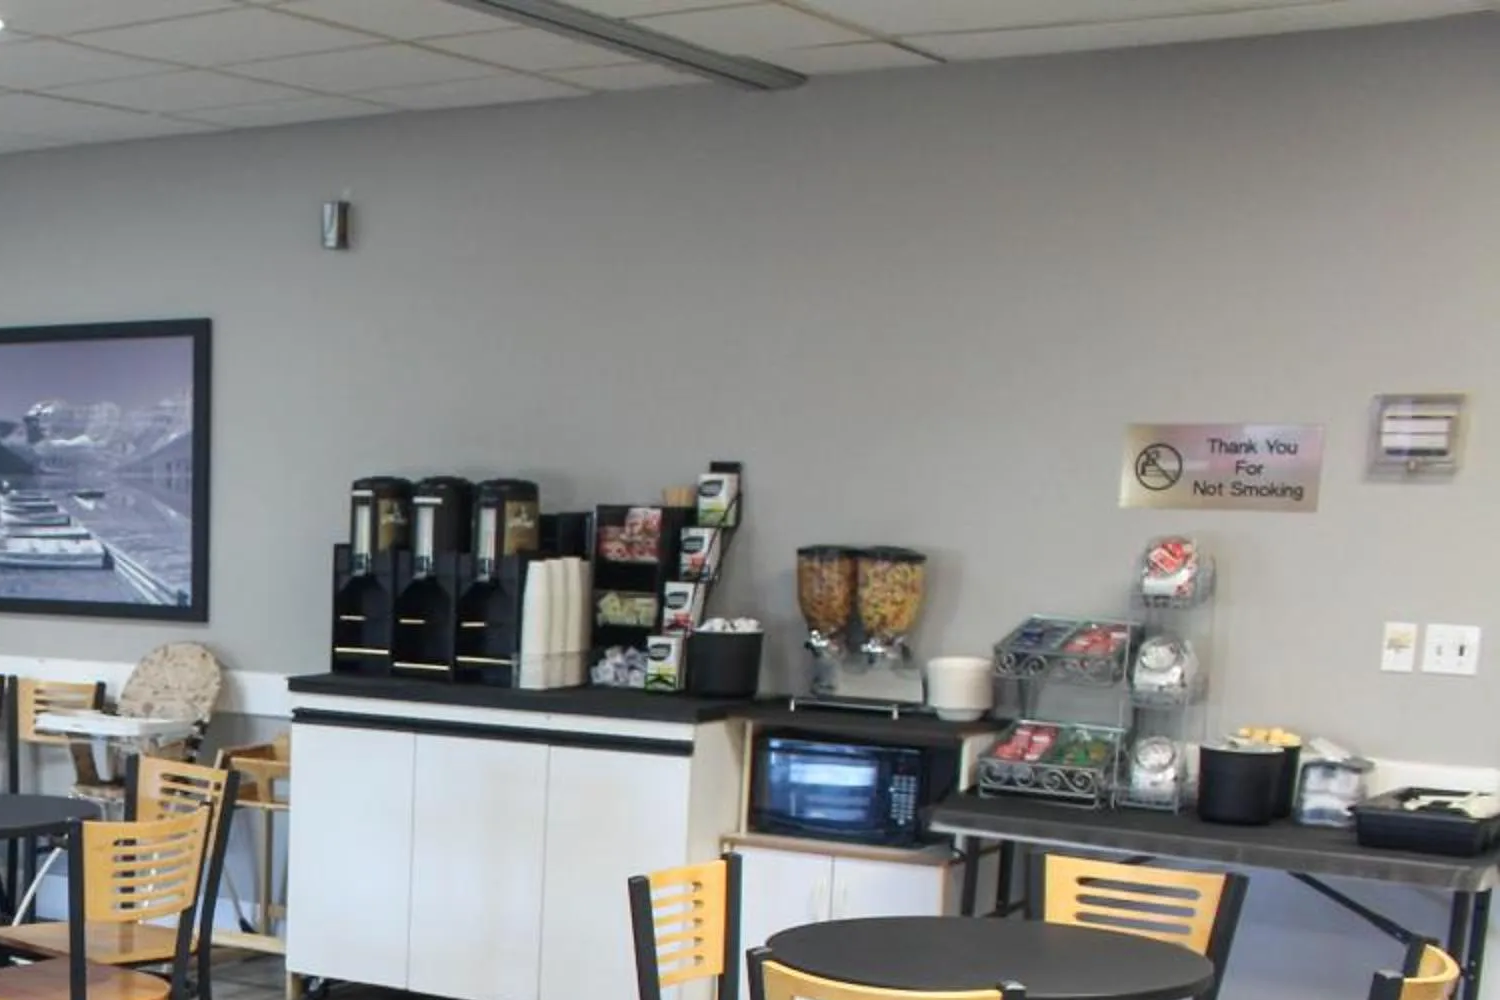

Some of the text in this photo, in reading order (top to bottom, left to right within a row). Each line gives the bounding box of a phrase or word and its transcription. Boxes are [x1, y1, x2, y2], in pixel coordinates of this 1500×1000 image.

[1206, 438, 1298, 454] Thank You
[1235, 460, 1263, 475] For
[1193, 480, 1304, 501] Not Smoking
